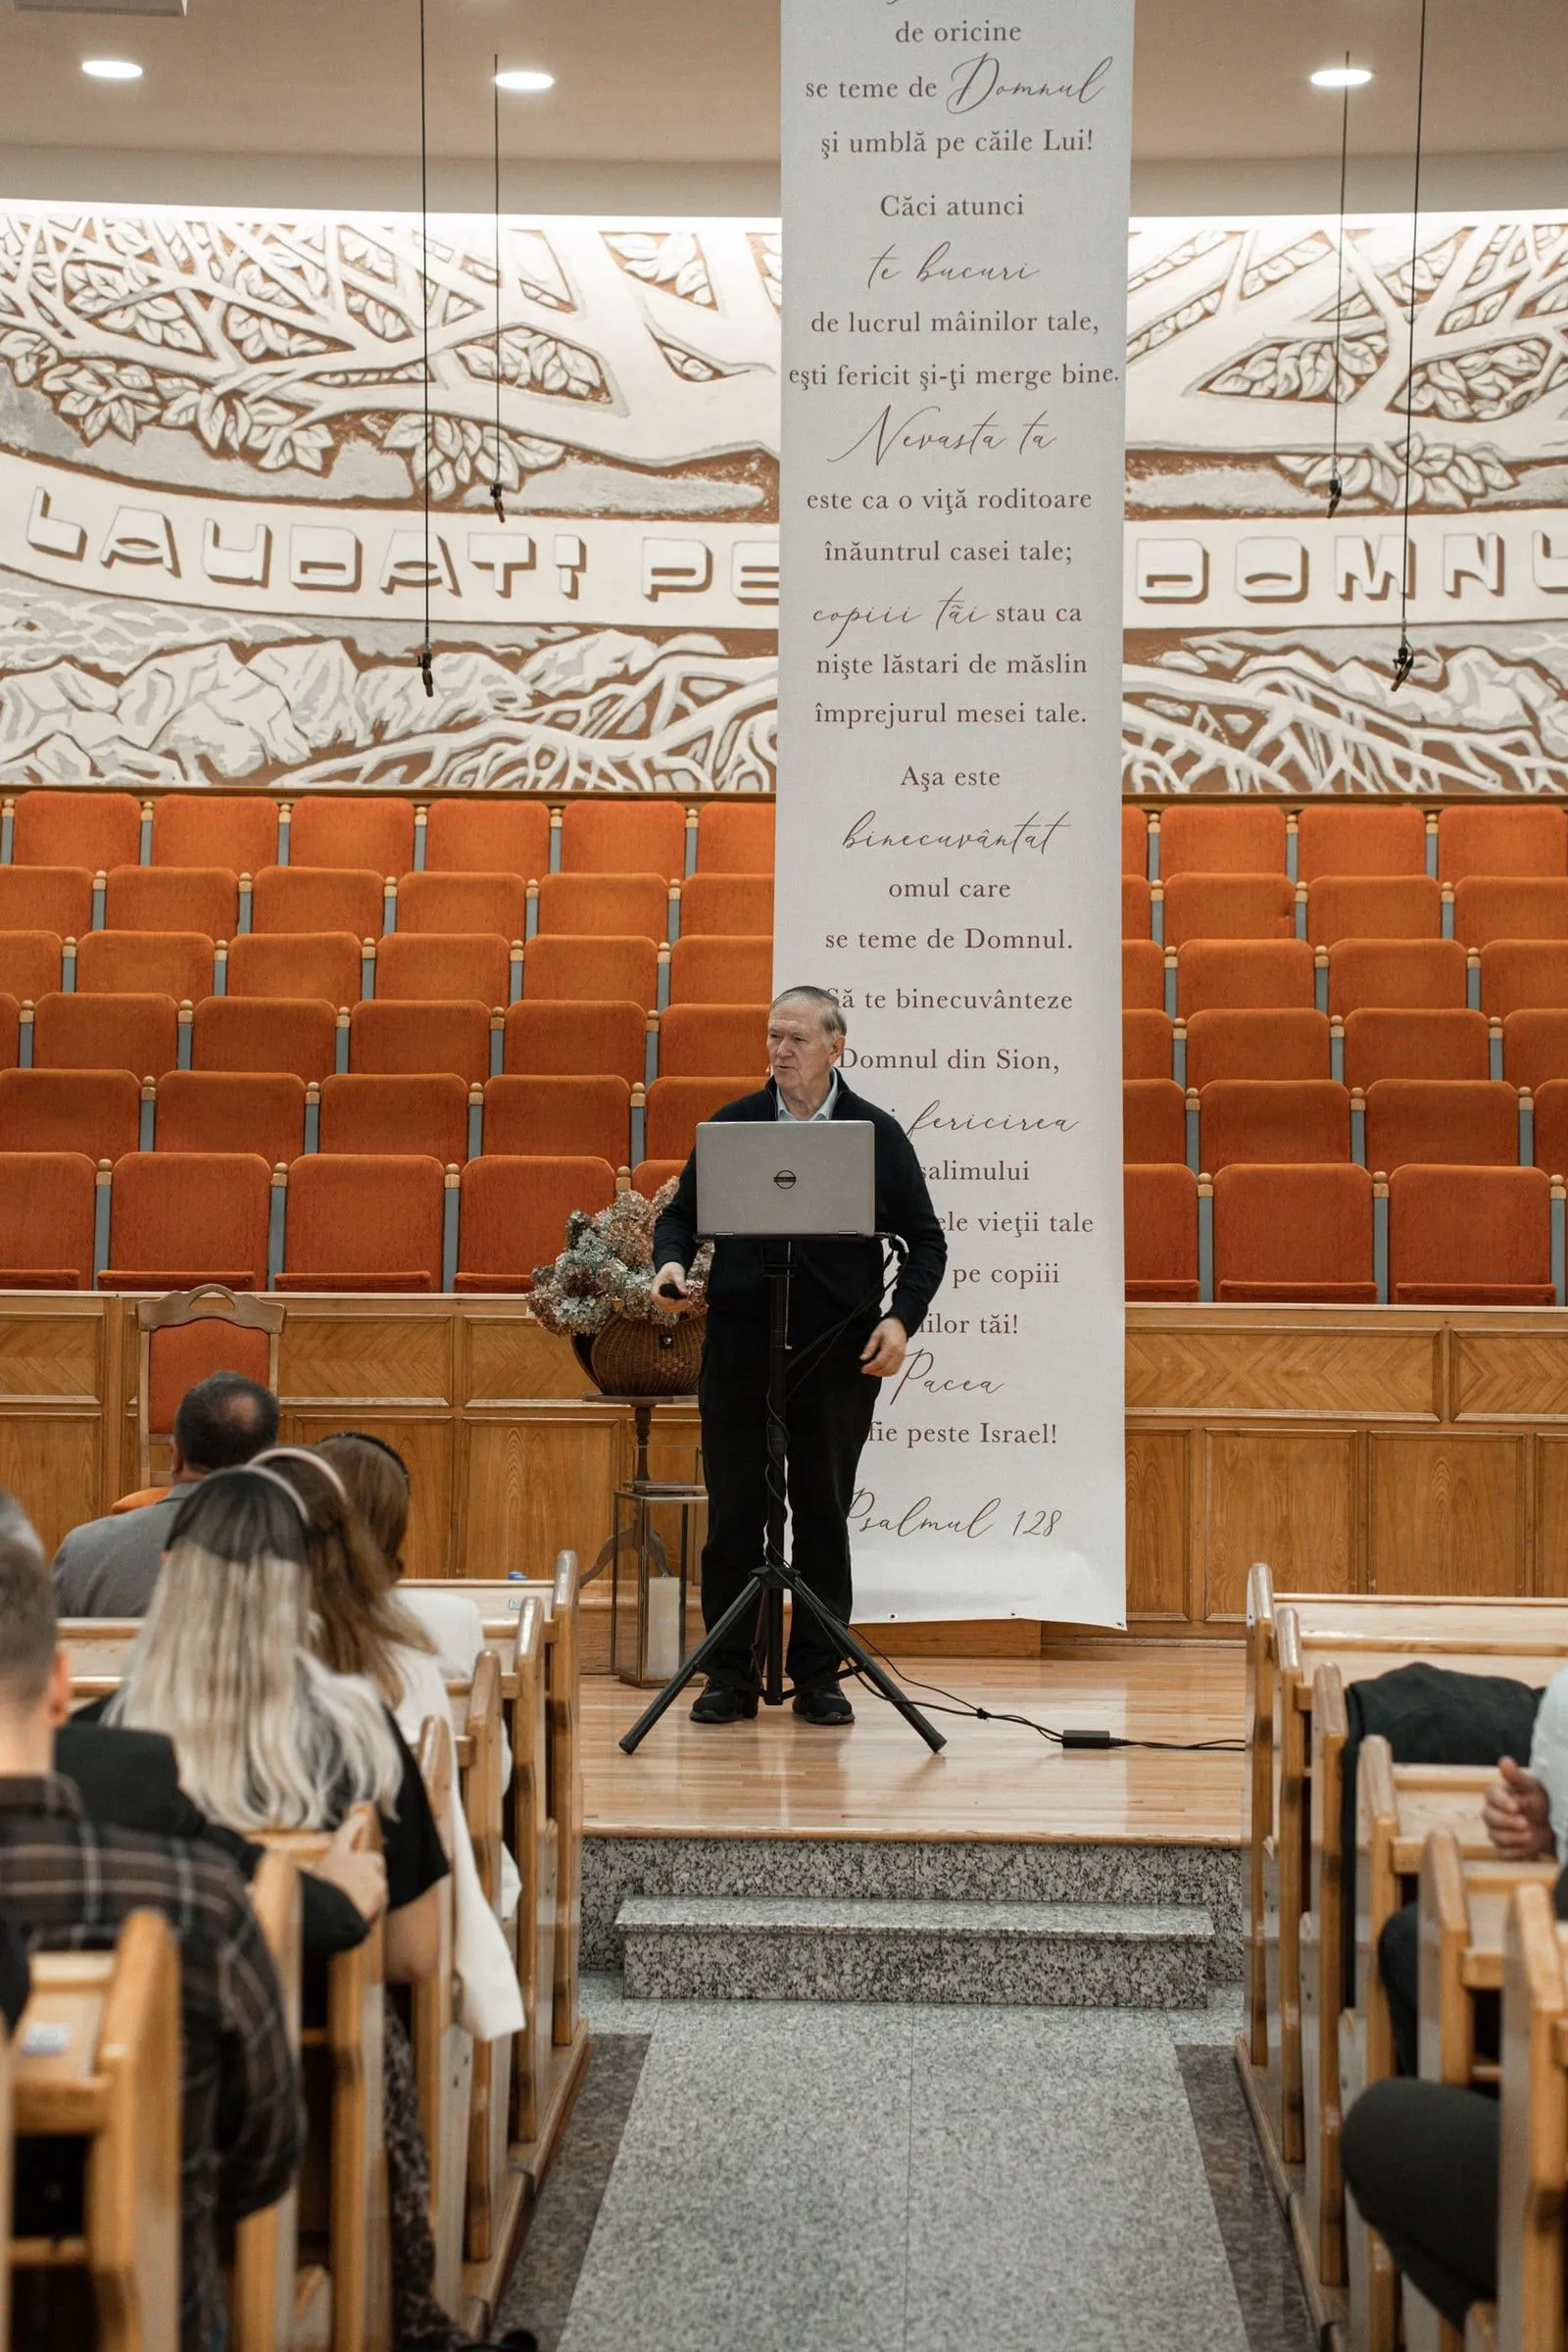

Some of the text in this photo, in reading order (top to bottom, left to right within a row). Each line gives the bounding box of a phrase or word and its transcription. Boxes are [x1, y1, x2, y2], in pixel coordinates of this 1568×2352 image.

[895, 19, 1022, 44] de oricine
[805, 51, 1114, 116] se teme de Domnul
[849, 129, 928, 154] umblă
[936, 136, 965, 160] pe
[974, 128, 1034, 153] căile
[1042, 128, 1093, 152] Lui!
[879, 193, 1024, 218] Căci atunci
[867, 240, 1041, 290] te bucuri
[810, 309, 1099, 335] de lucrul mâinilor tale,
[836, 363, 910, 387] fericit
[975, 369, 1053, 392] merge
[1061, 362, 1120, 385] bine.
[826, 403, 1057, 467] Nevasta ta
[807, 492, 853, 511] este
[861, 494, 890, 511] ca
[898, 494, 913, 511] o
[977, 486, 1093, 510] roditoare
[824, 539, 1072, 565] înăuntrul casei tale;
[812, 606, 923, 650] copiii
[996, 605, 1047, 623] stau
[1054, 607, 1083, 623] ca
[882, 652, 959, 675] lăstari
[968, 652, 997, 675] de
[1006, 652, 1088, 674] măslin
[814, 701, 1087, 730] împrejurul mesei tale.
[954, 769, 1001, 787] este
[842, 809, 1071, 856] binecuvântat
[888, 876, 1011, 899] omul care
[825, 927, 1073, 950] se teme de Domnul.
[863, 992, 887, 1009] te
[895, 988, 1073, 1011] binecuvânteze
[837, 1047, 1059, 1075] Domnul din Sion,
[937, 1210, 969, 1234] ele
[1049, 1211, 1094, 1234] tale
[952, 1261, 1060, 1291] pe copiii
[979, 1312, 1018, 1335] tăi!
[889, 1347, 1005, 1406] Pacea
[867, 1420, 1056, 1449] fie peste Israel!
[1011, 1509, 1062, 1538] 128
